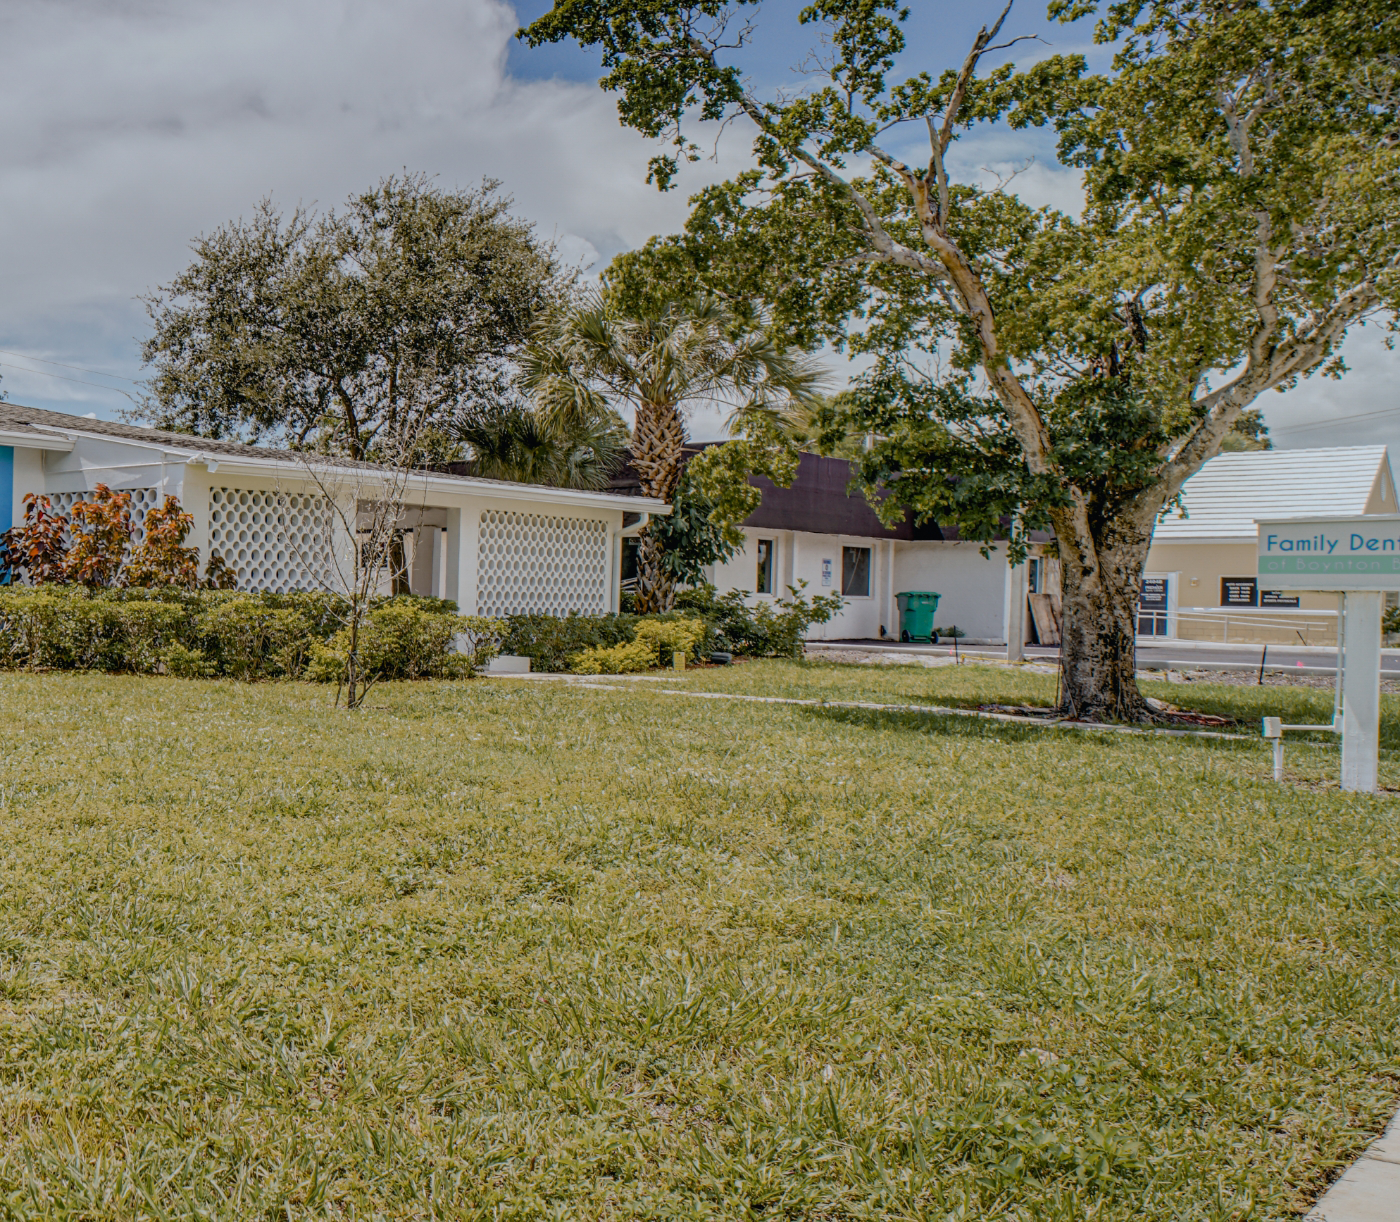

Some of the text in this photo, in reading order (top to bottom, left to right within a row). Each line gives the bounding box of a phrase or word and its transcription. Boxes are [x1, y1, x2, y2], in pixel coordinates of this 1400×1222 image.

[1267, 534, 1400, 554] Family Den
[1268, 558, 1287, 570] of
[1296, 558, 1380, 572] Boynton
